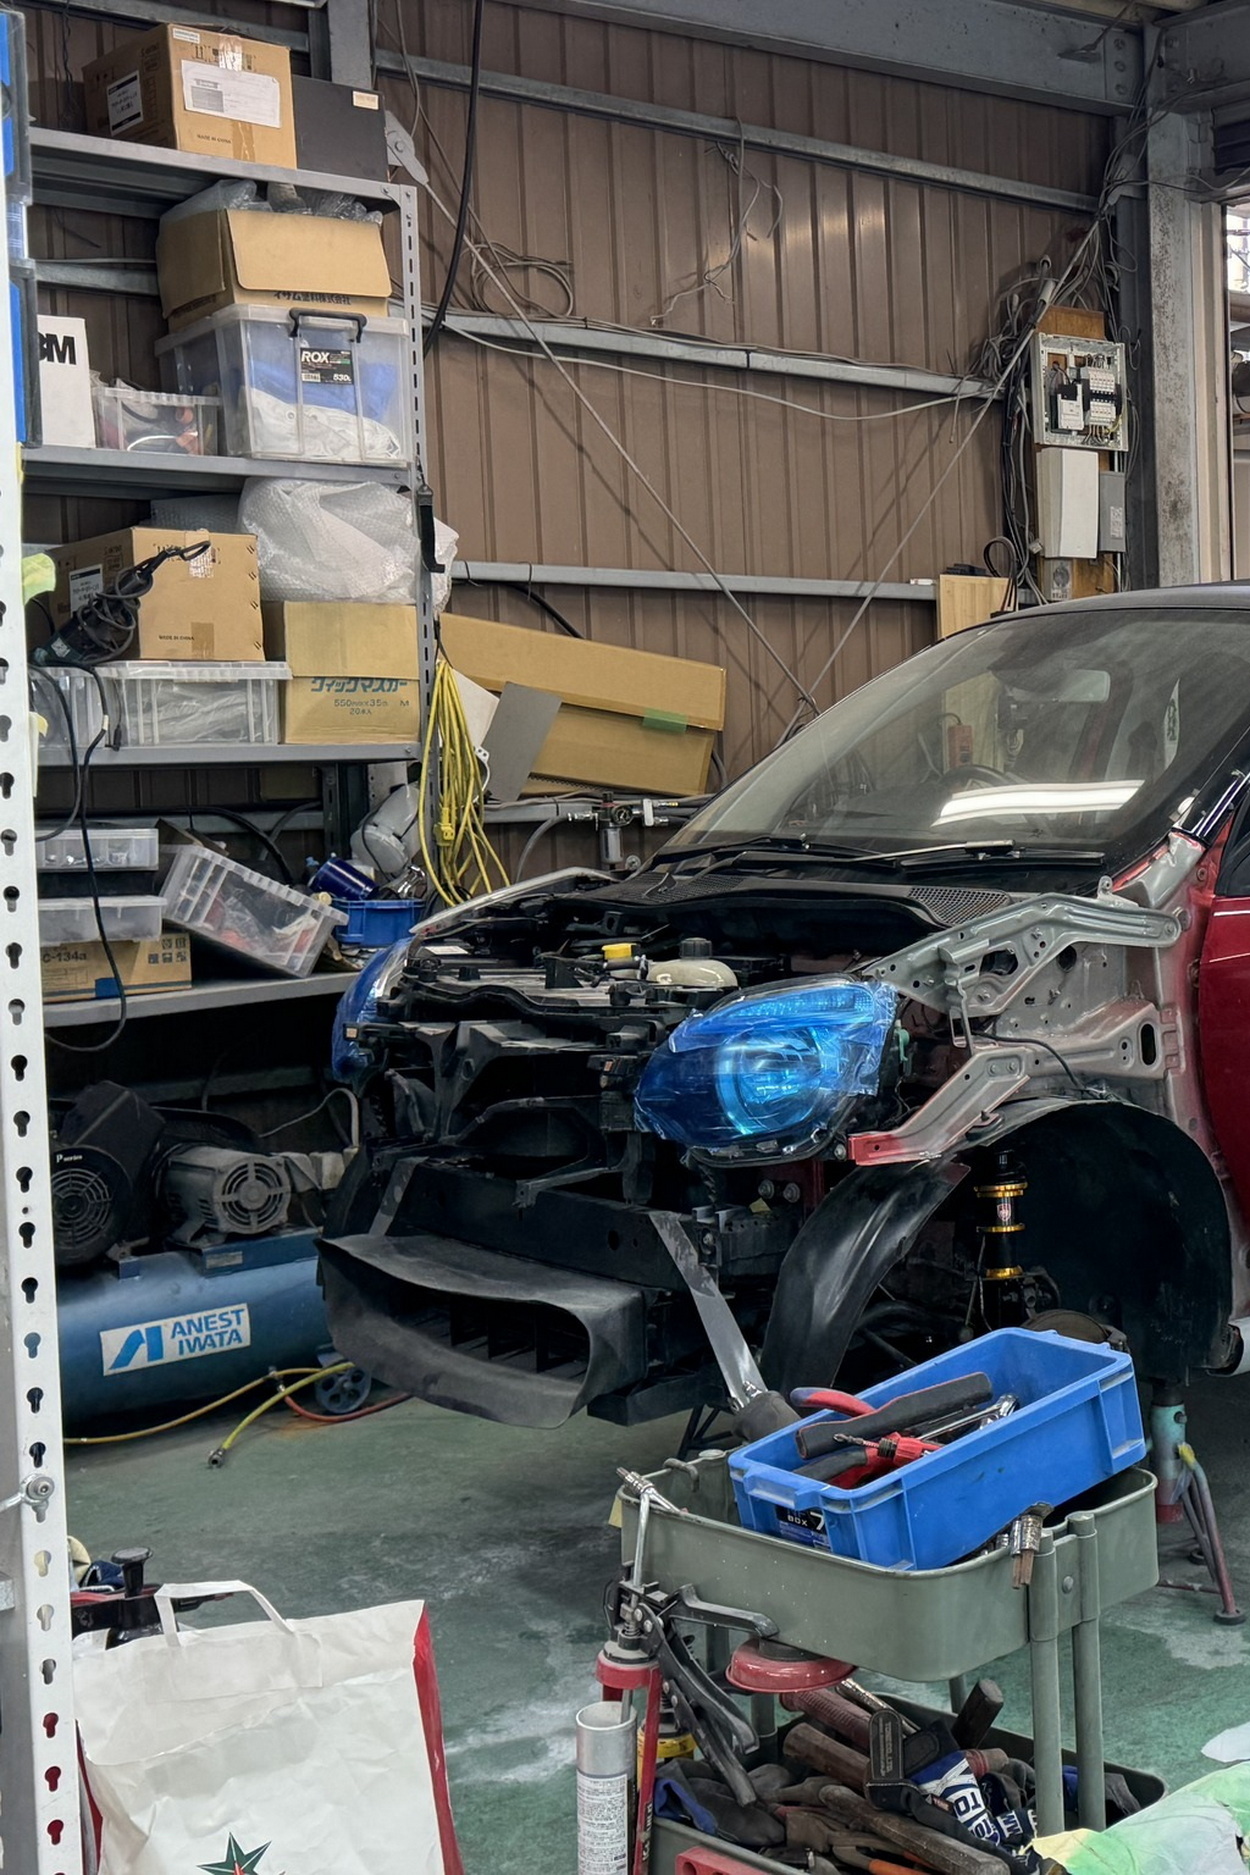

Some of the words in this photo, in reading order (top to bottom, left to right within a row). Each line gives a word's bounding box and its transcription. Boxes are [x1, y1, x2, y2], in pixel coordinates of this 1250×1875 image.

[301, 351, 330, 364] ROX
[170, 1308, 245, 1340] ANEST
[178, 1328, 243, 1356] IWATA
[787, 1514, 808, 1527] BOX
